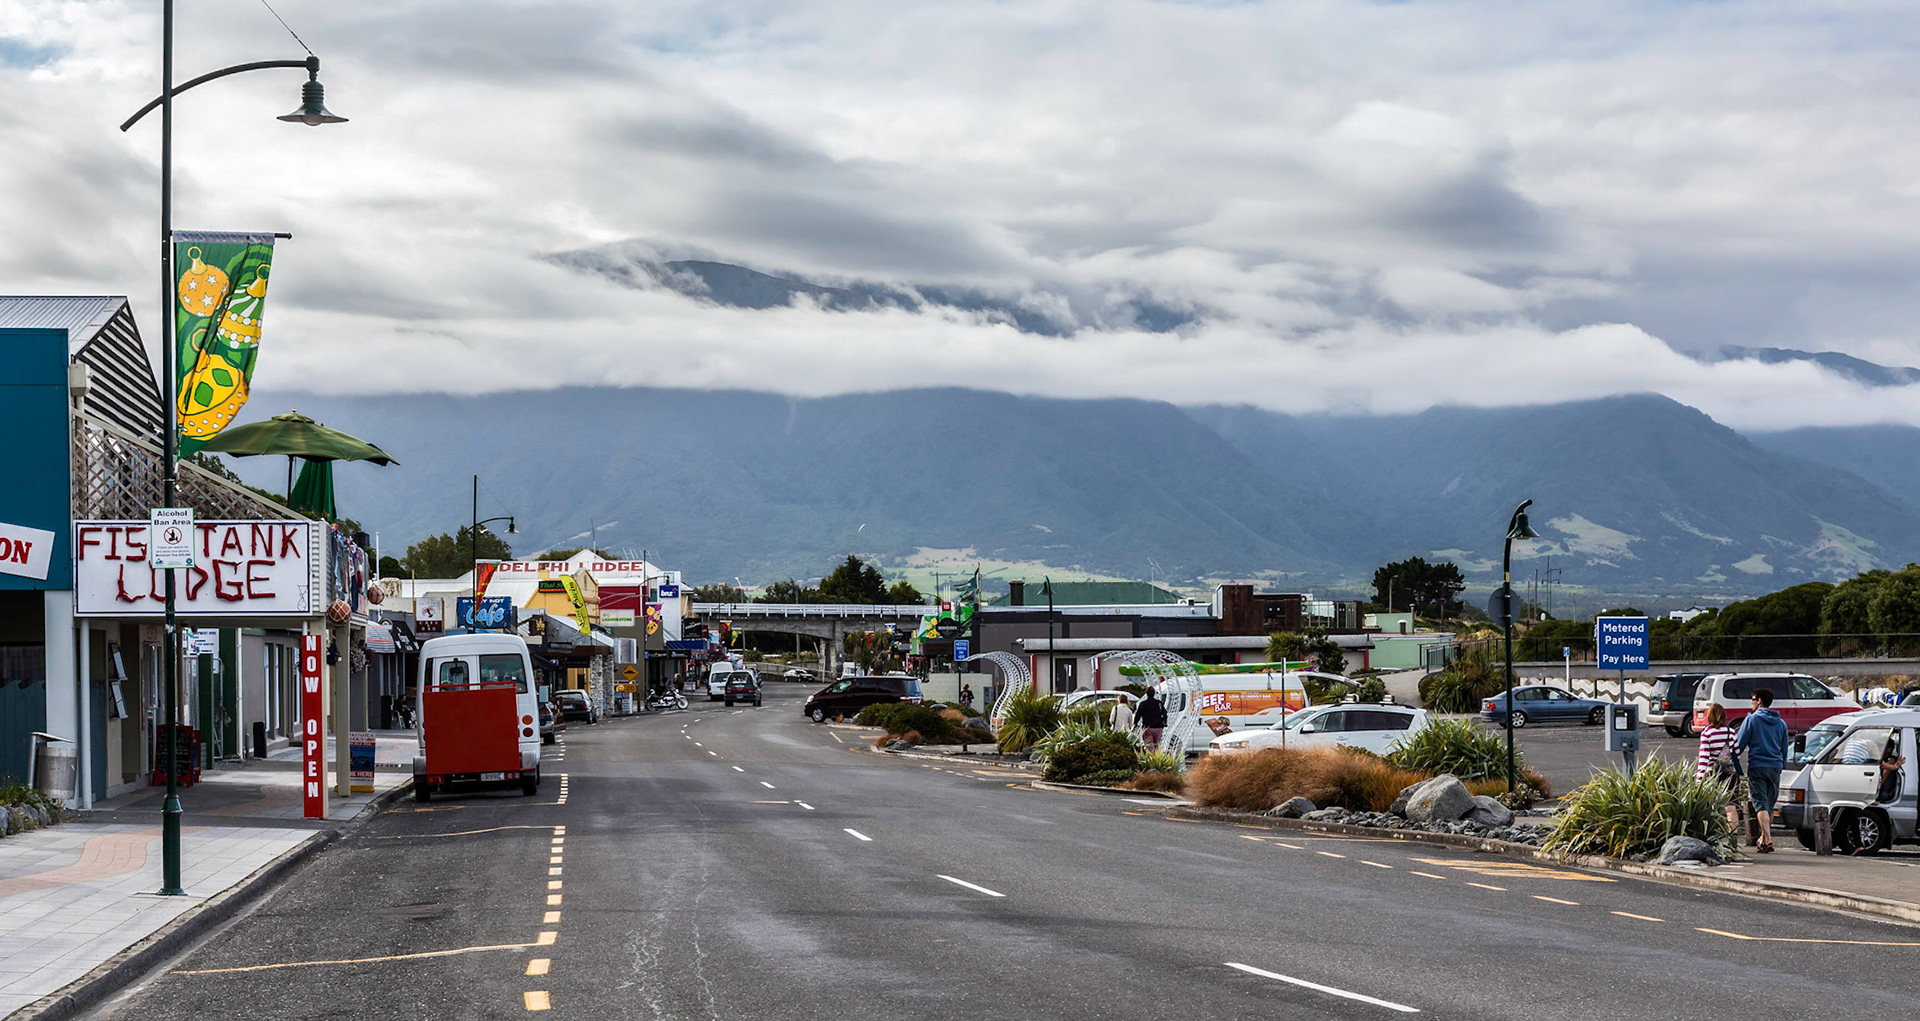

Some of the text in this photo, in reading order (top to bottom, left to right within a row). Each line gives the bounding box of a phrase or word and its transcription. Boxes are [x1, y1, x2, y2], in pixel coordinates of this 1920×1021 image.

[79, 523, 301, 562] FIS TANK
[660, 589, 674, 597] bnz
[1602, 623, 1645, 633] Metered
[1605, 635, 1643, 647] Parking
[304, 635, 319, 693] NOW
[1602, 654, 1645, 664] Pay Here
[1202, 693, 1225, 708] EEF
[1214, 702, 1232, 713] BAR
[306, 718, 319, 798] OPEN
